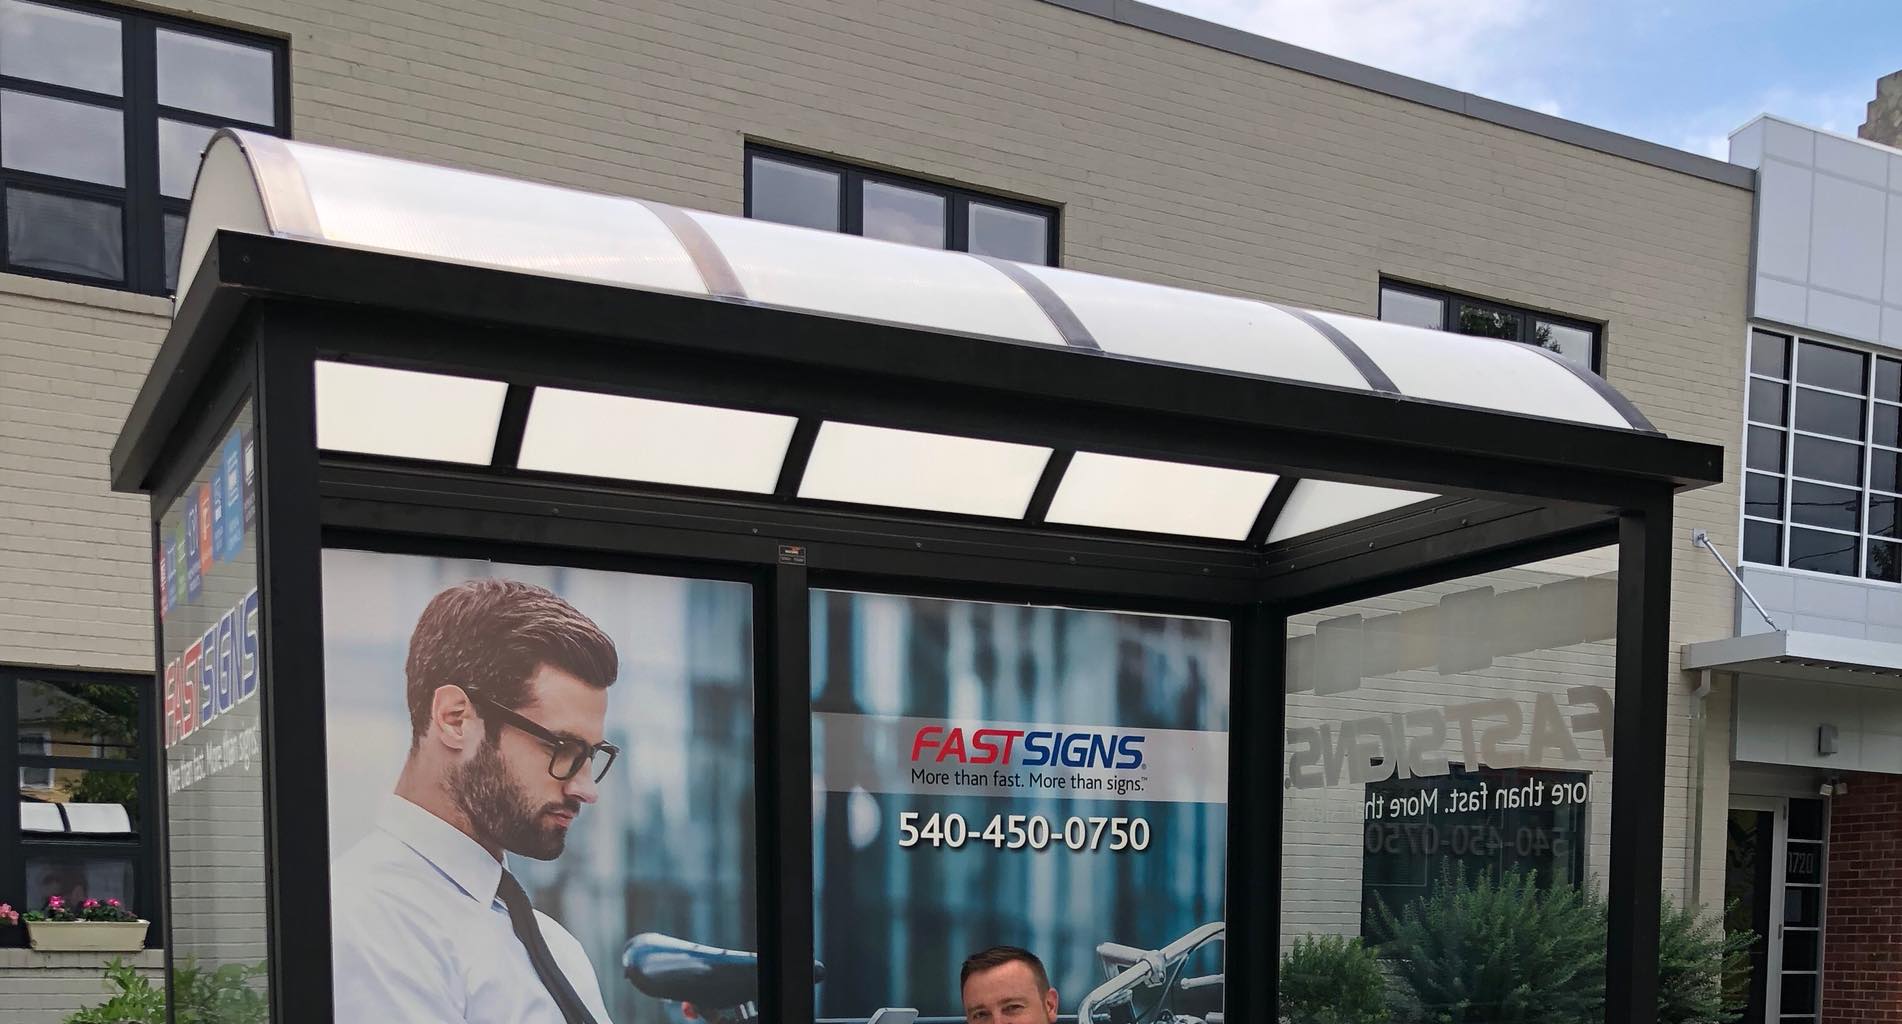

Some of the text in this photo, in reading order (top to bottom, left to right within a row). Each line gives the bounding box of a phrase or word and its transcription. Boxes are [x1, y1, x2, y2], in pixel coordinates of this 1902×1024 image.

[165, 586, 259, 750] FASTSIGNS
[911, 726, 1146, 770] FASTSIGNS
[911, 768, 949, 785] More
[955, 769, 988, 787] than
[993, 771, 1024, 788] fast.
[1030, 773, 1066, 789] More
[1071, 773, 1102, 790] than
[899, 812, 1150, 851] 540-450-0750
[1788, 852, 1813, 874] 1720
